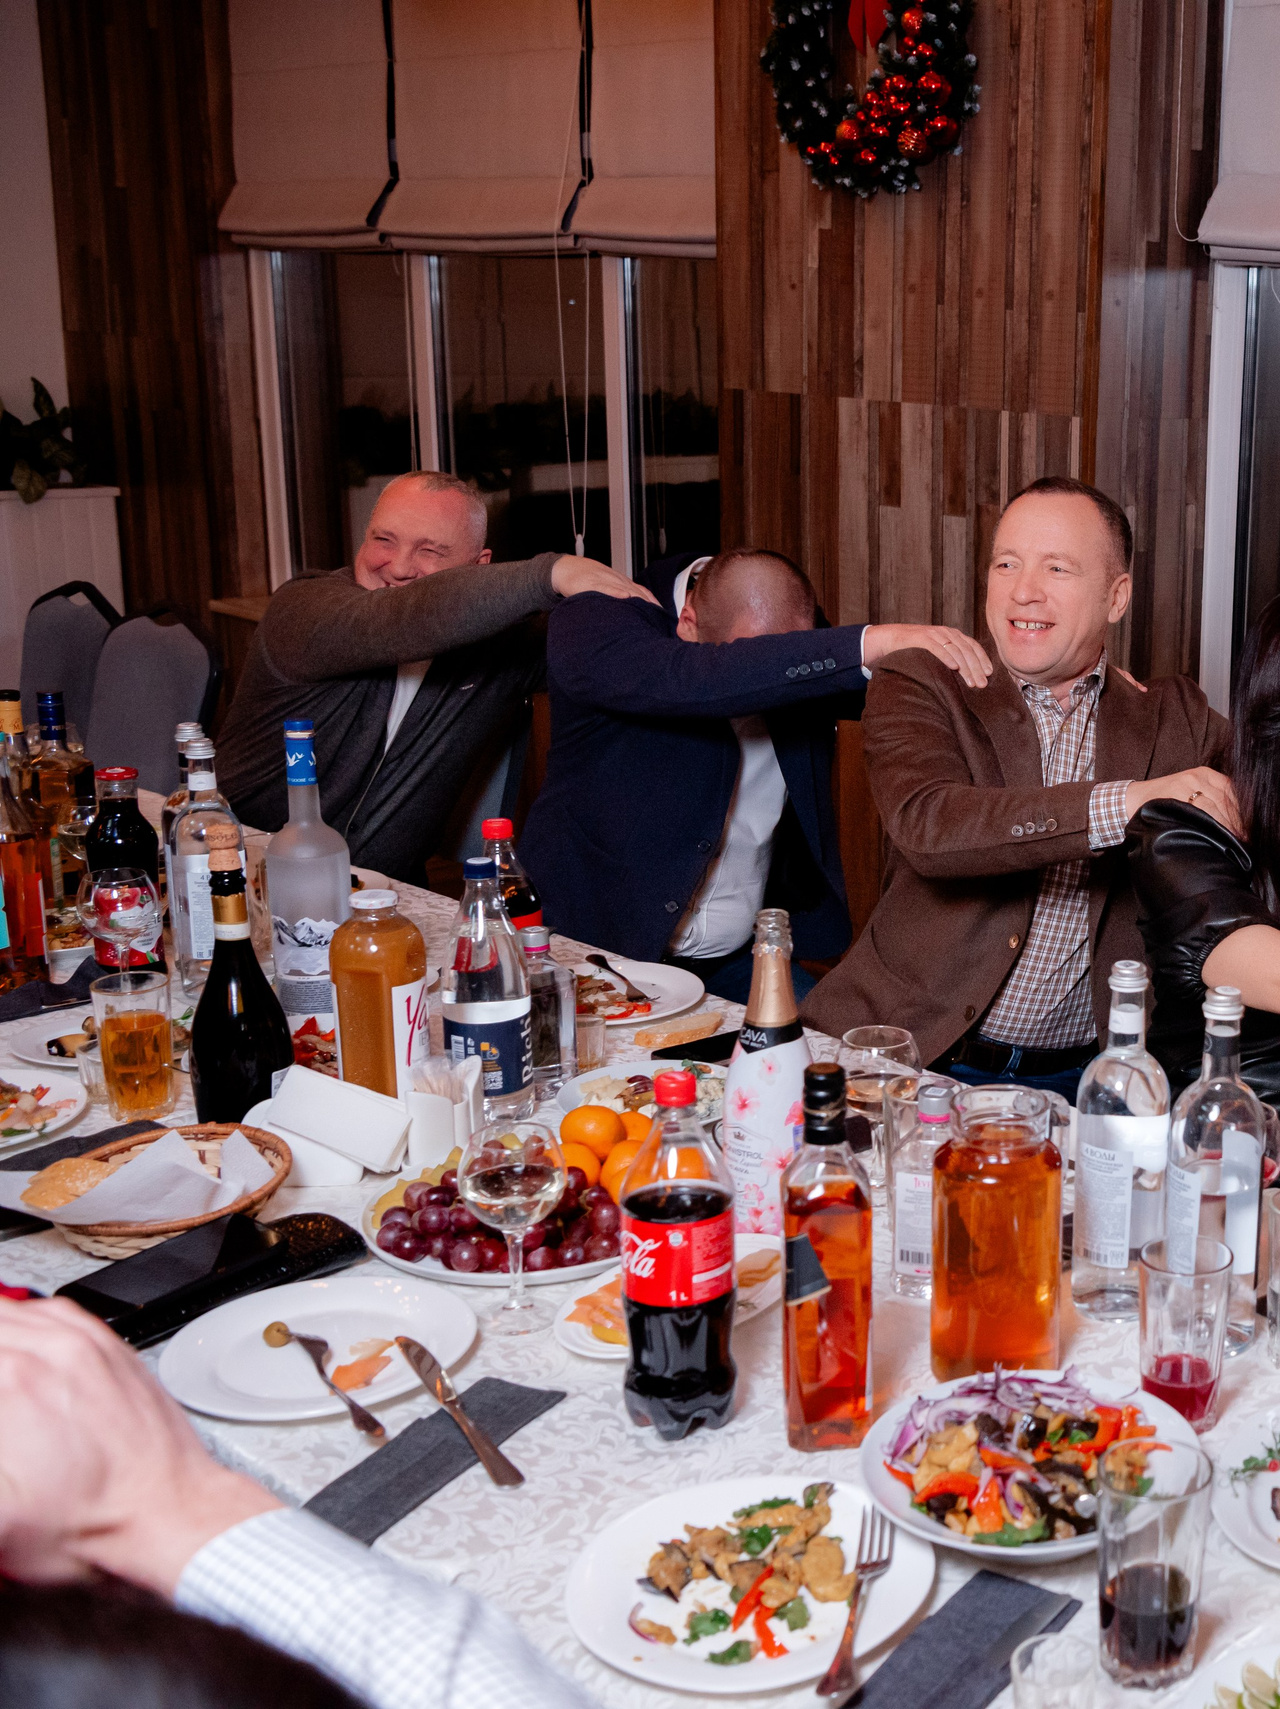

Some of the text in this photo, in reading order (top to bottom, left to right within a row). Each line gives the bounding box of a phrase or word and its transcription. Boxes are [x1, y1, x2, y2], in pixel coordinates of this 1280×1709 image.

[739, 1026, 768, 1045] CAVA
[520, 1016, 534, 1084] Rich
[669, 1290, 677, 1300] 1
